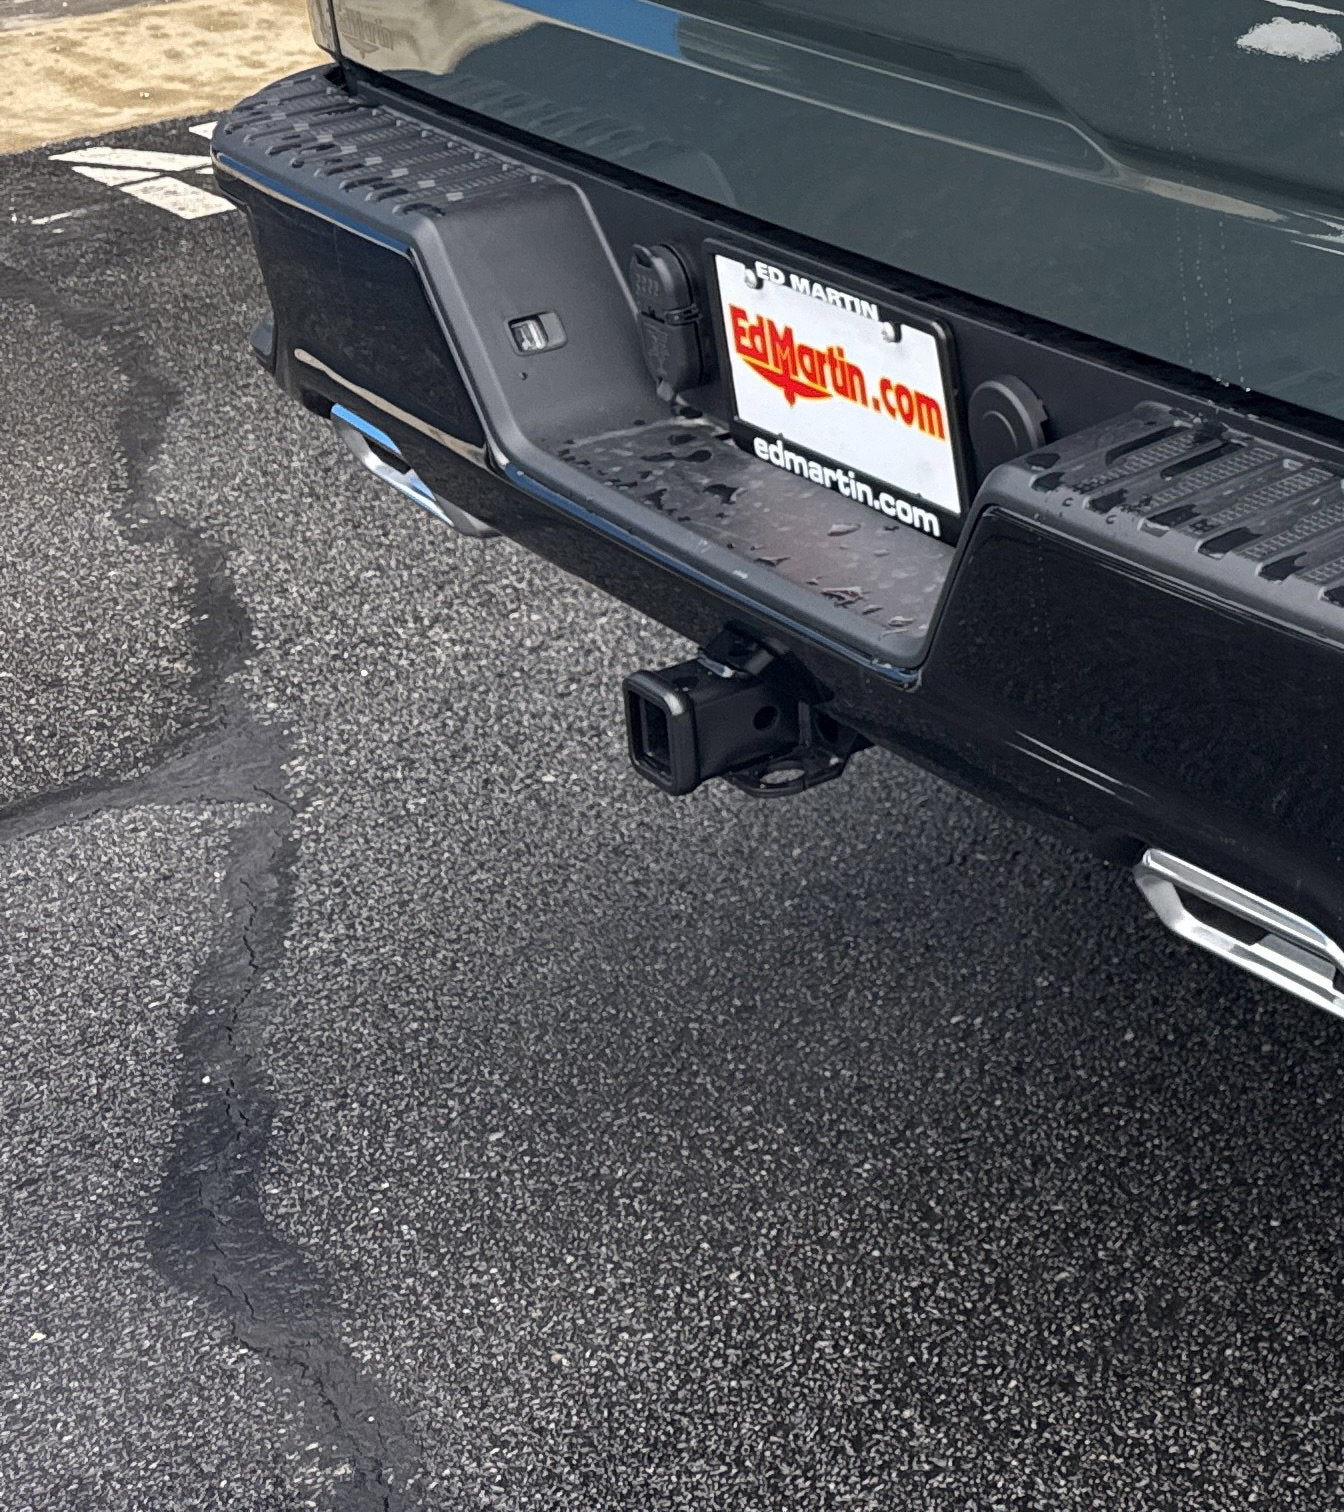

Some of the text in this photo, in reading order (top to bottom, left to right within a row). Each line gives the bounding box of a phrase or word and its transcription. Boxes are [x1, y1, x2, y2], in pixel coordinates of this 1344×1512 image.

[754, 261, 879, 322] ED MARTIN
[753, 436, 941, 537] edmartin.com
